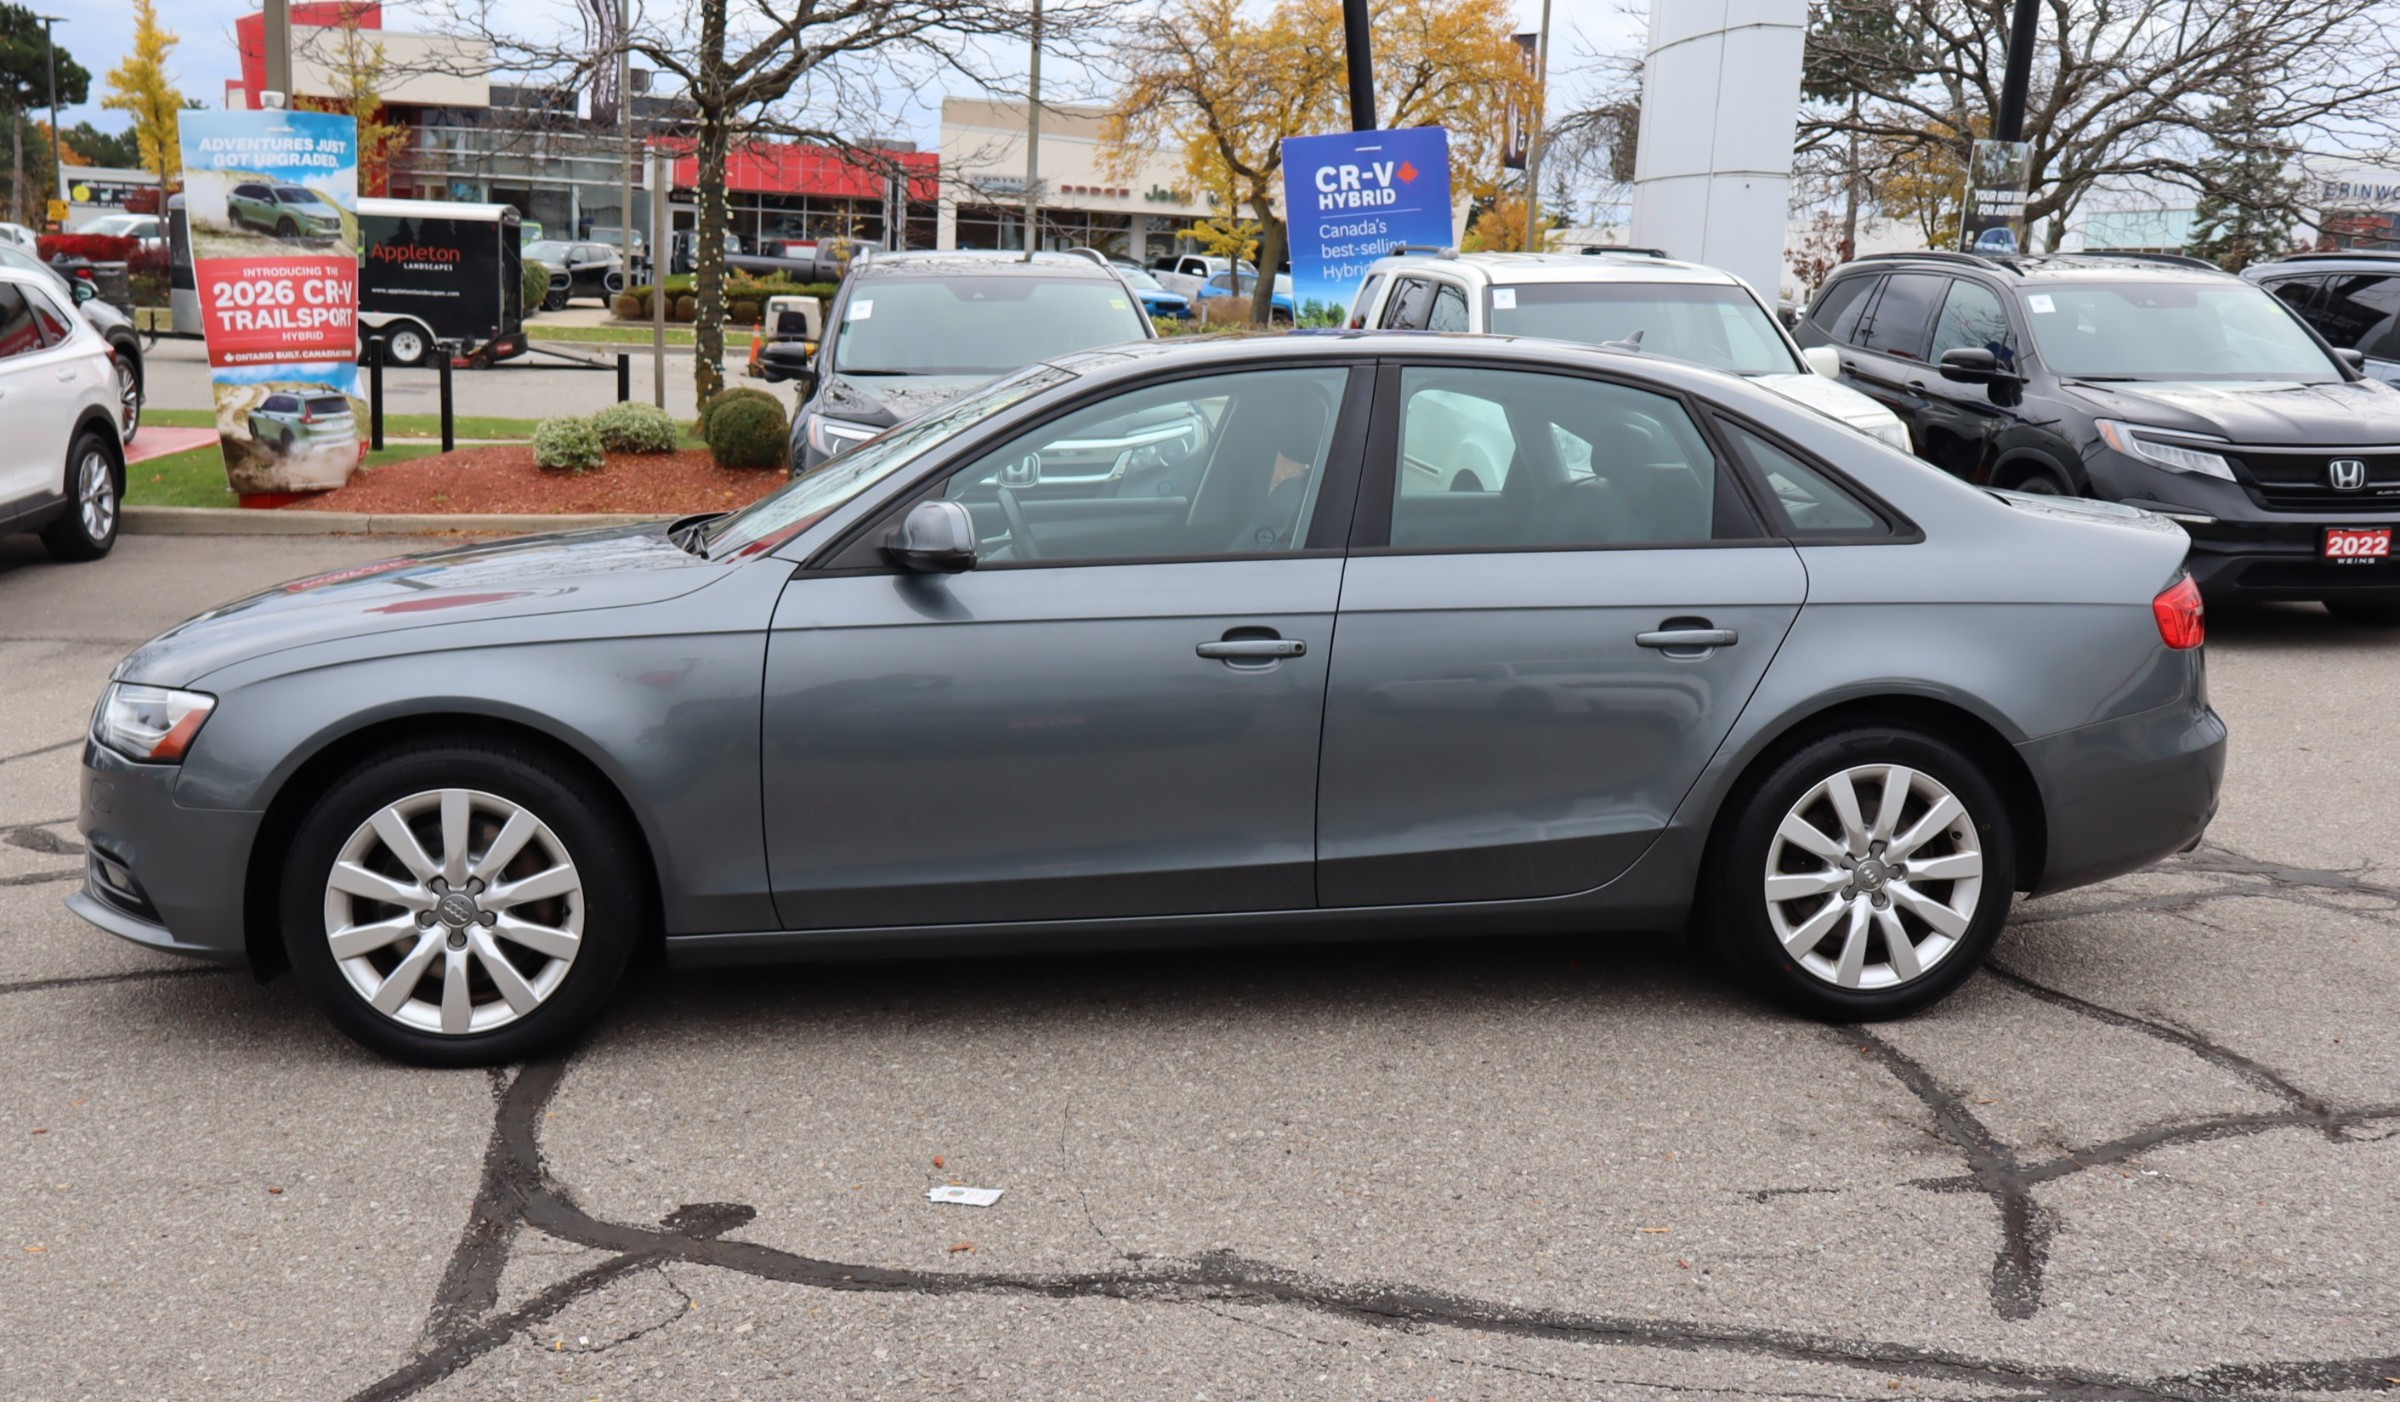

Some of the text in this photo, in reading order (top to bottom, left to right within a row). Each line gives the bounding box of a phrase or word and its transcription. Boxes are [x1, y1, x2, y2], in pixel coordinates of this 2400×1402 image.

[200, 138, 346, 154] ADVENTURES JUST
[213, 153, 340, 168] GOT UPGRADED.
[1315, 161, 1394, 193] CR-V
[1318, 188, 1396, 210] HYBRID
[1977, 203, 1996, 215] FOR
[1319, 218, 1388, 239] Canada's
[371, 241, 462, 263] Appleton
[243, 266, 339, 277] INTRODUCING THE
[403, 262, 453, 271] LANDSCAPES
[213, 279, 353, 307] 2026 CR-V
[217, 307, 353, 331] TRAILSPORT
[282, 331, 324, 341] HYBRID
[235, 352, 274, 362] ONTARIO
[2326, 536, 2389, 556] 2022
